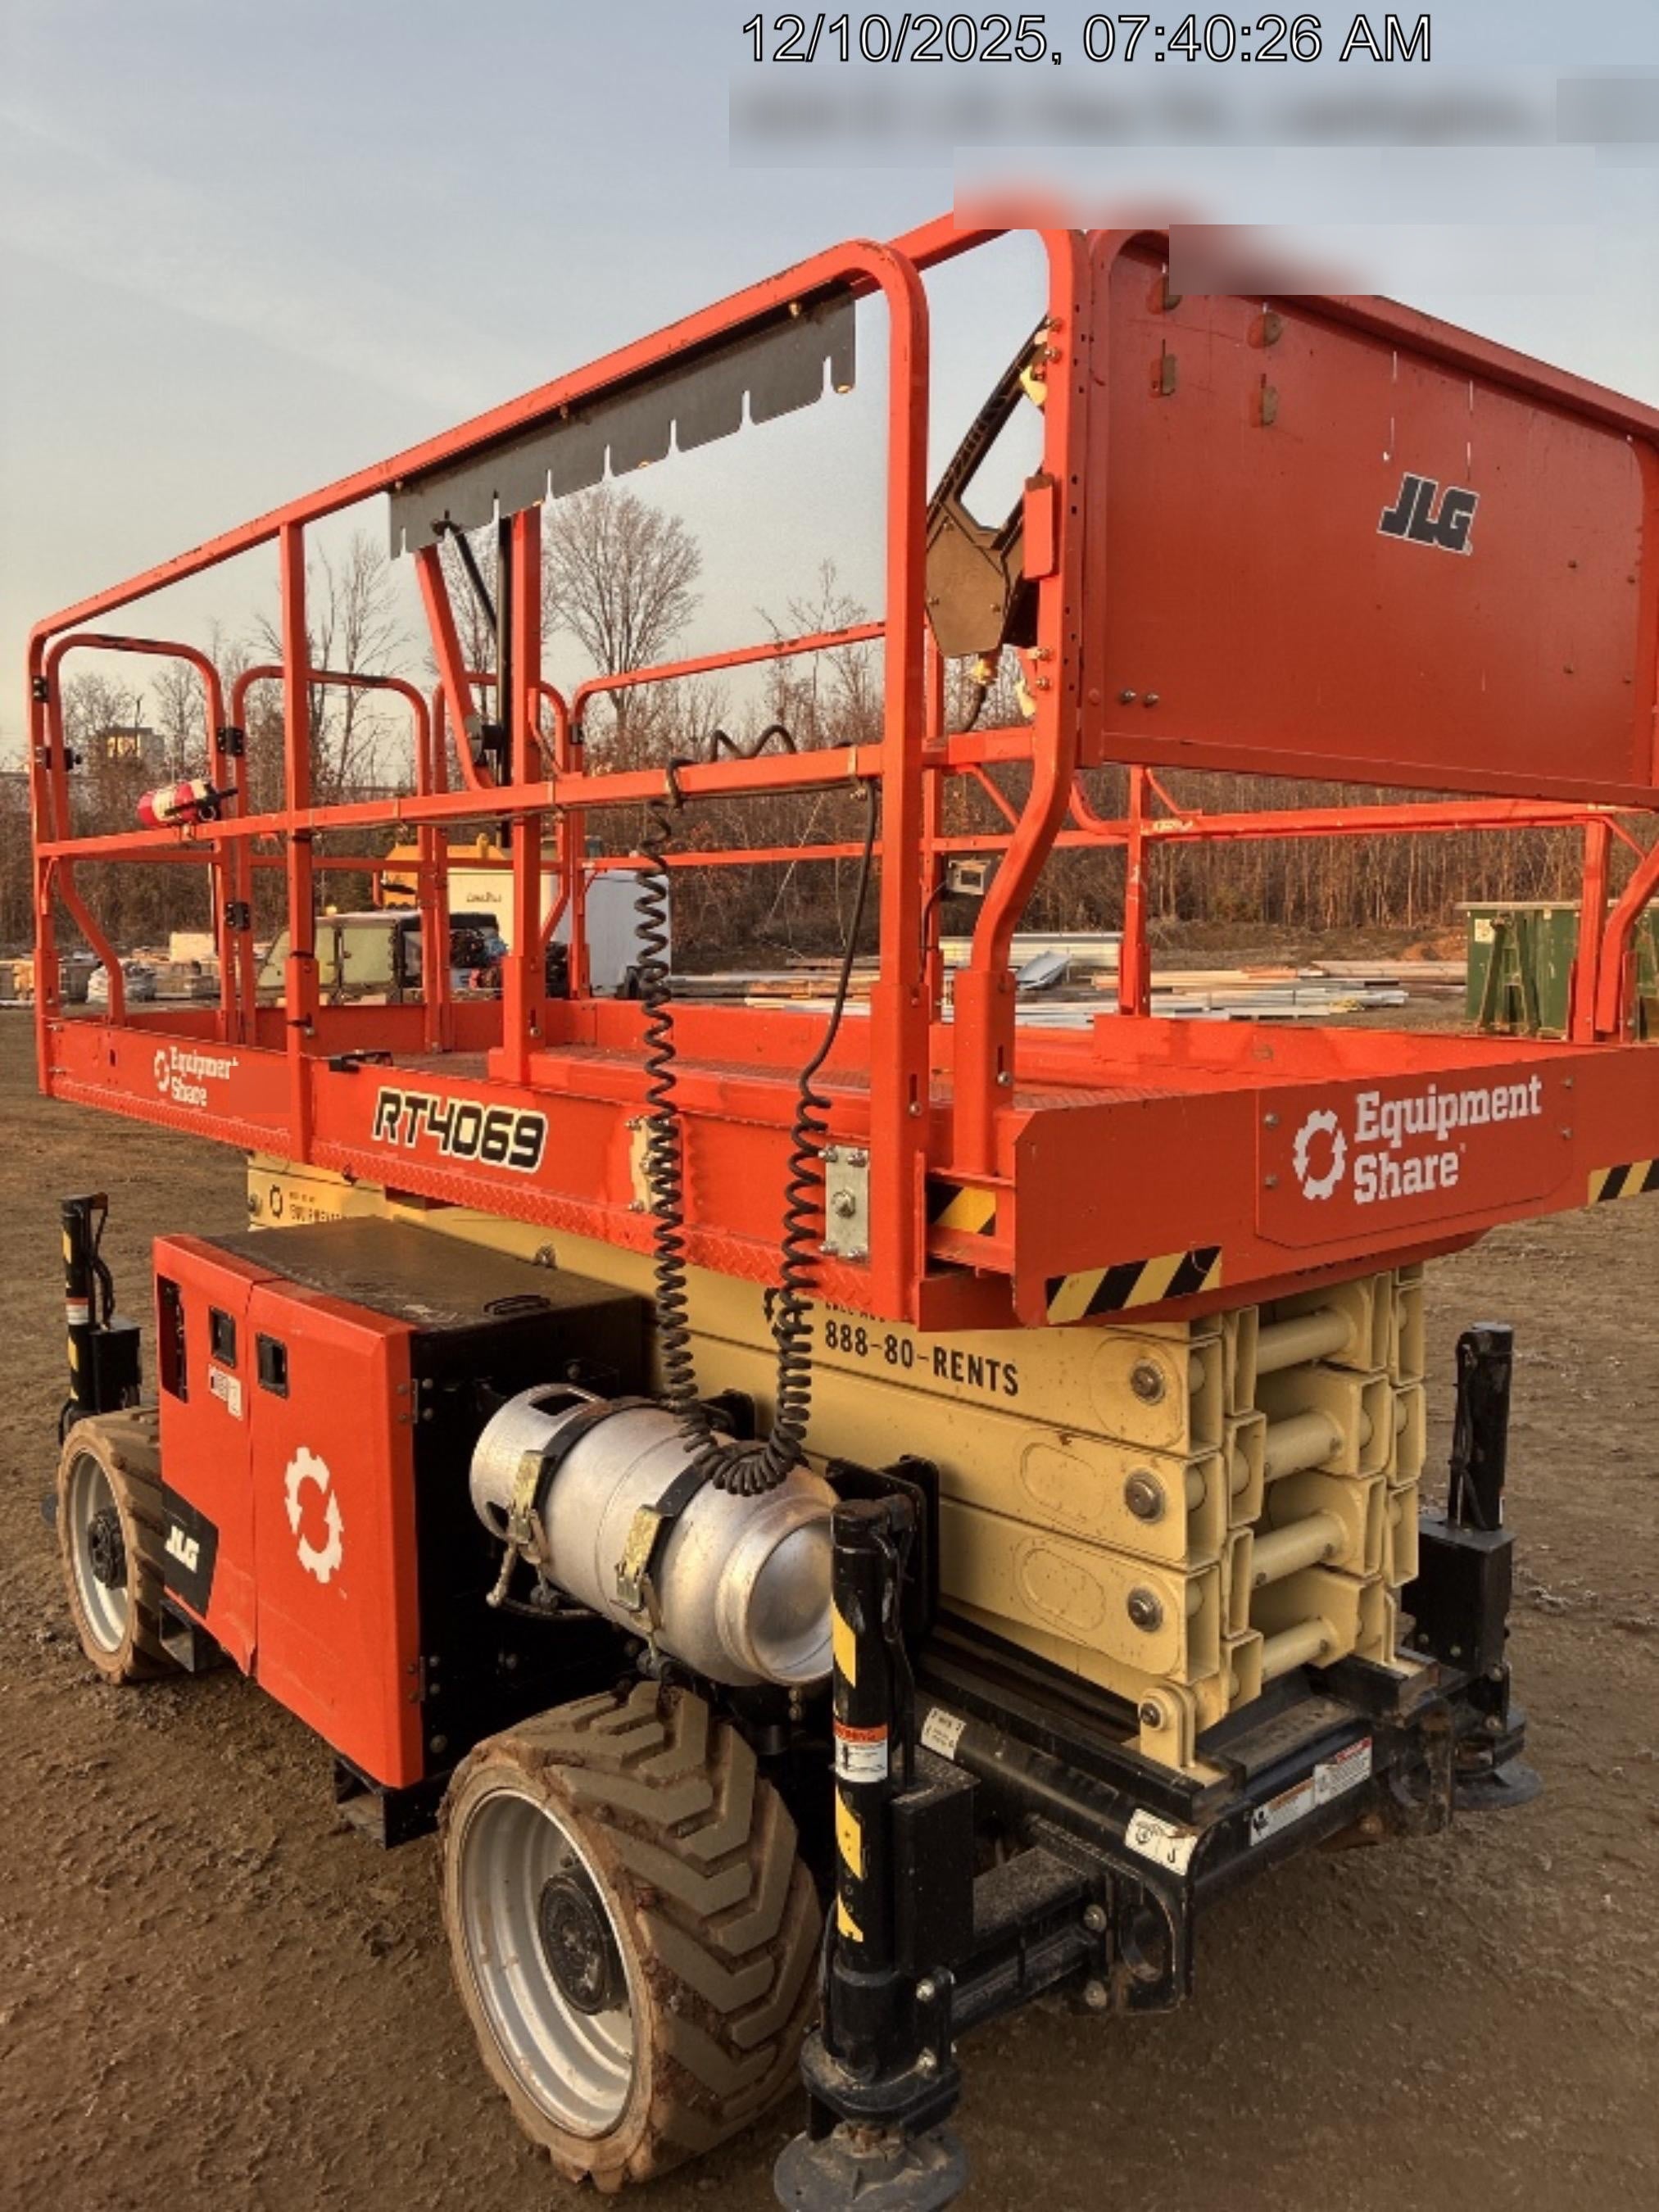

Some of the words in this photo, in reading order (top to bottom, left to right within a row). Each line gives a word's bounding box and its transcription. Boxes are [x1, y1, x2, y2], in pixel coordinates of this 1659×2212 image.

[1376, 472, 1480, 556] JLG
[372, 1086, 548, 1173] RT4069
[1354, 1073, 1542, 1149] Equipment
[1353, 1150, 1459, 1204] Share
[825, 1319, 1019, 1396] 888-80-RENTS
[165, 1525, 200, 1573] JLG
